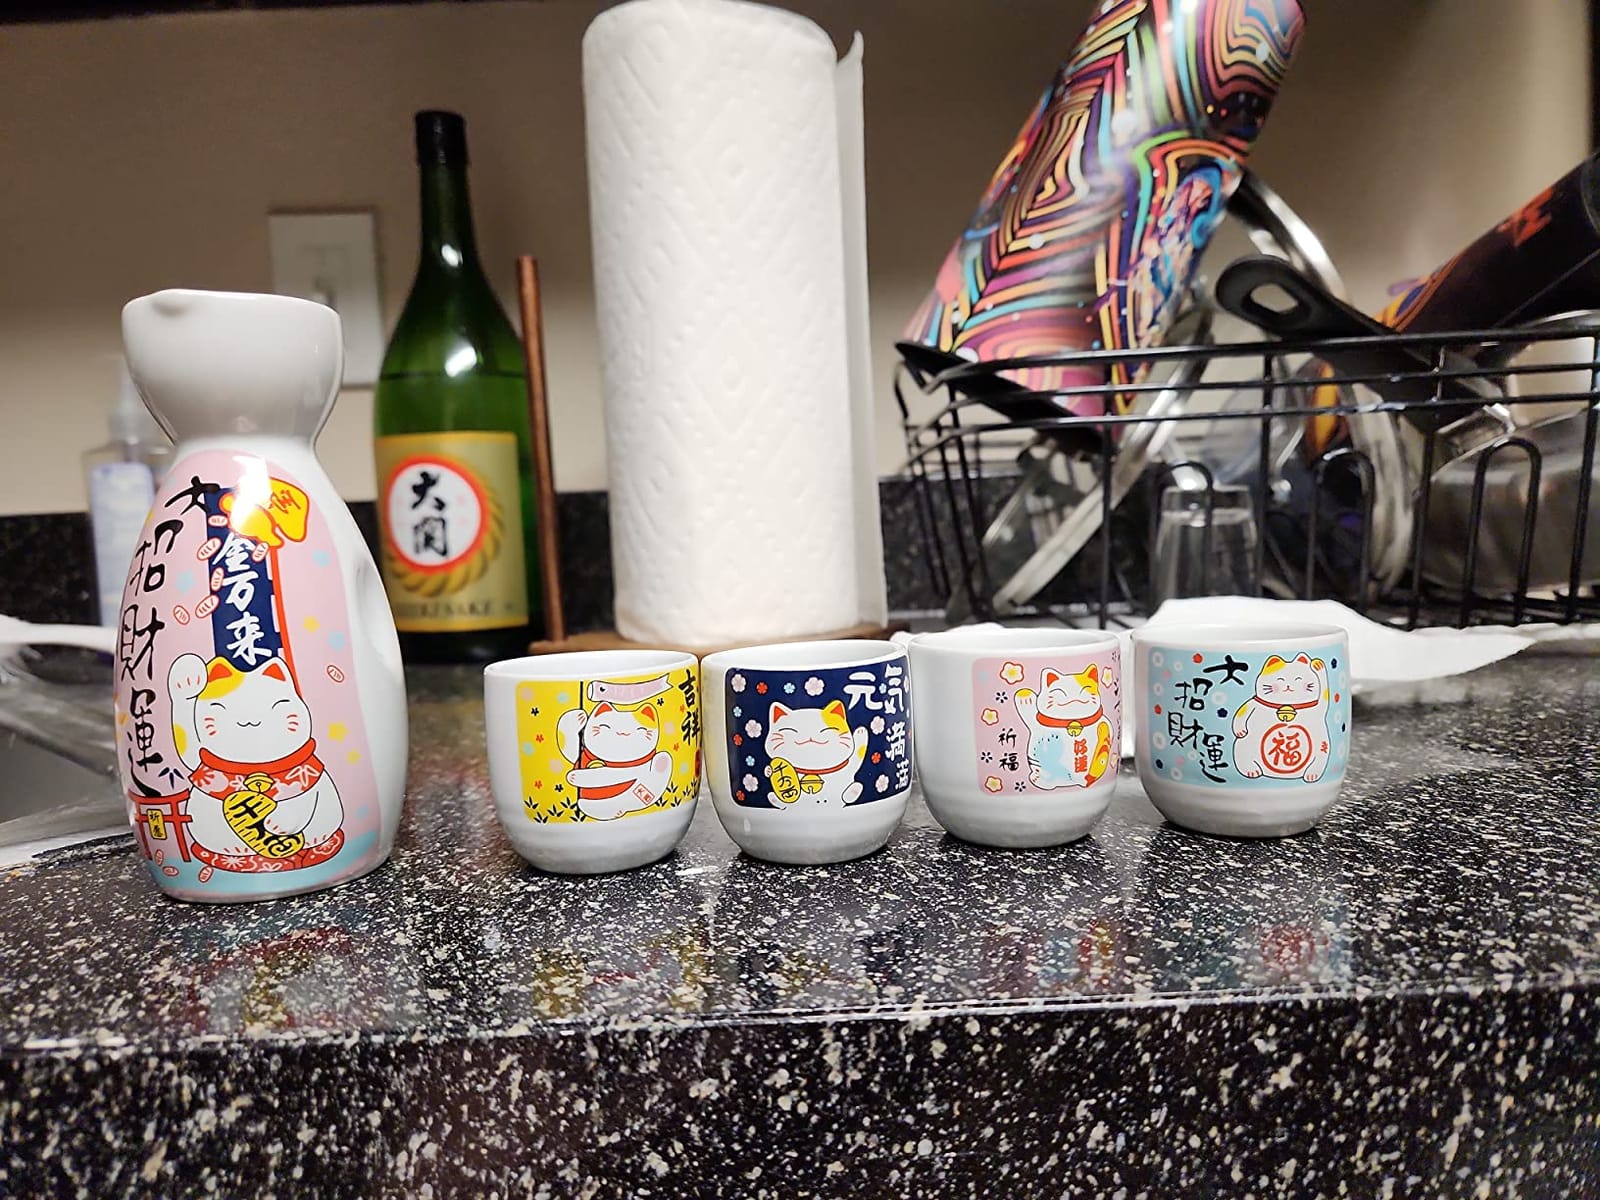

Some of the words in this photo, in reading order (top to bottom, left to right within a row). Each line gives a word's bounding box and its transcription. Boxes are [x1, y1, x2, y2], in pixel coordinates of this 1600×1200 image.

[117, 476, 221, 798] 大招財運
[998, 727, 1020, 772] 祈福
[1167, 654, 1249, 783] 大招財運
[1268, 731, 1302, 766] 福
